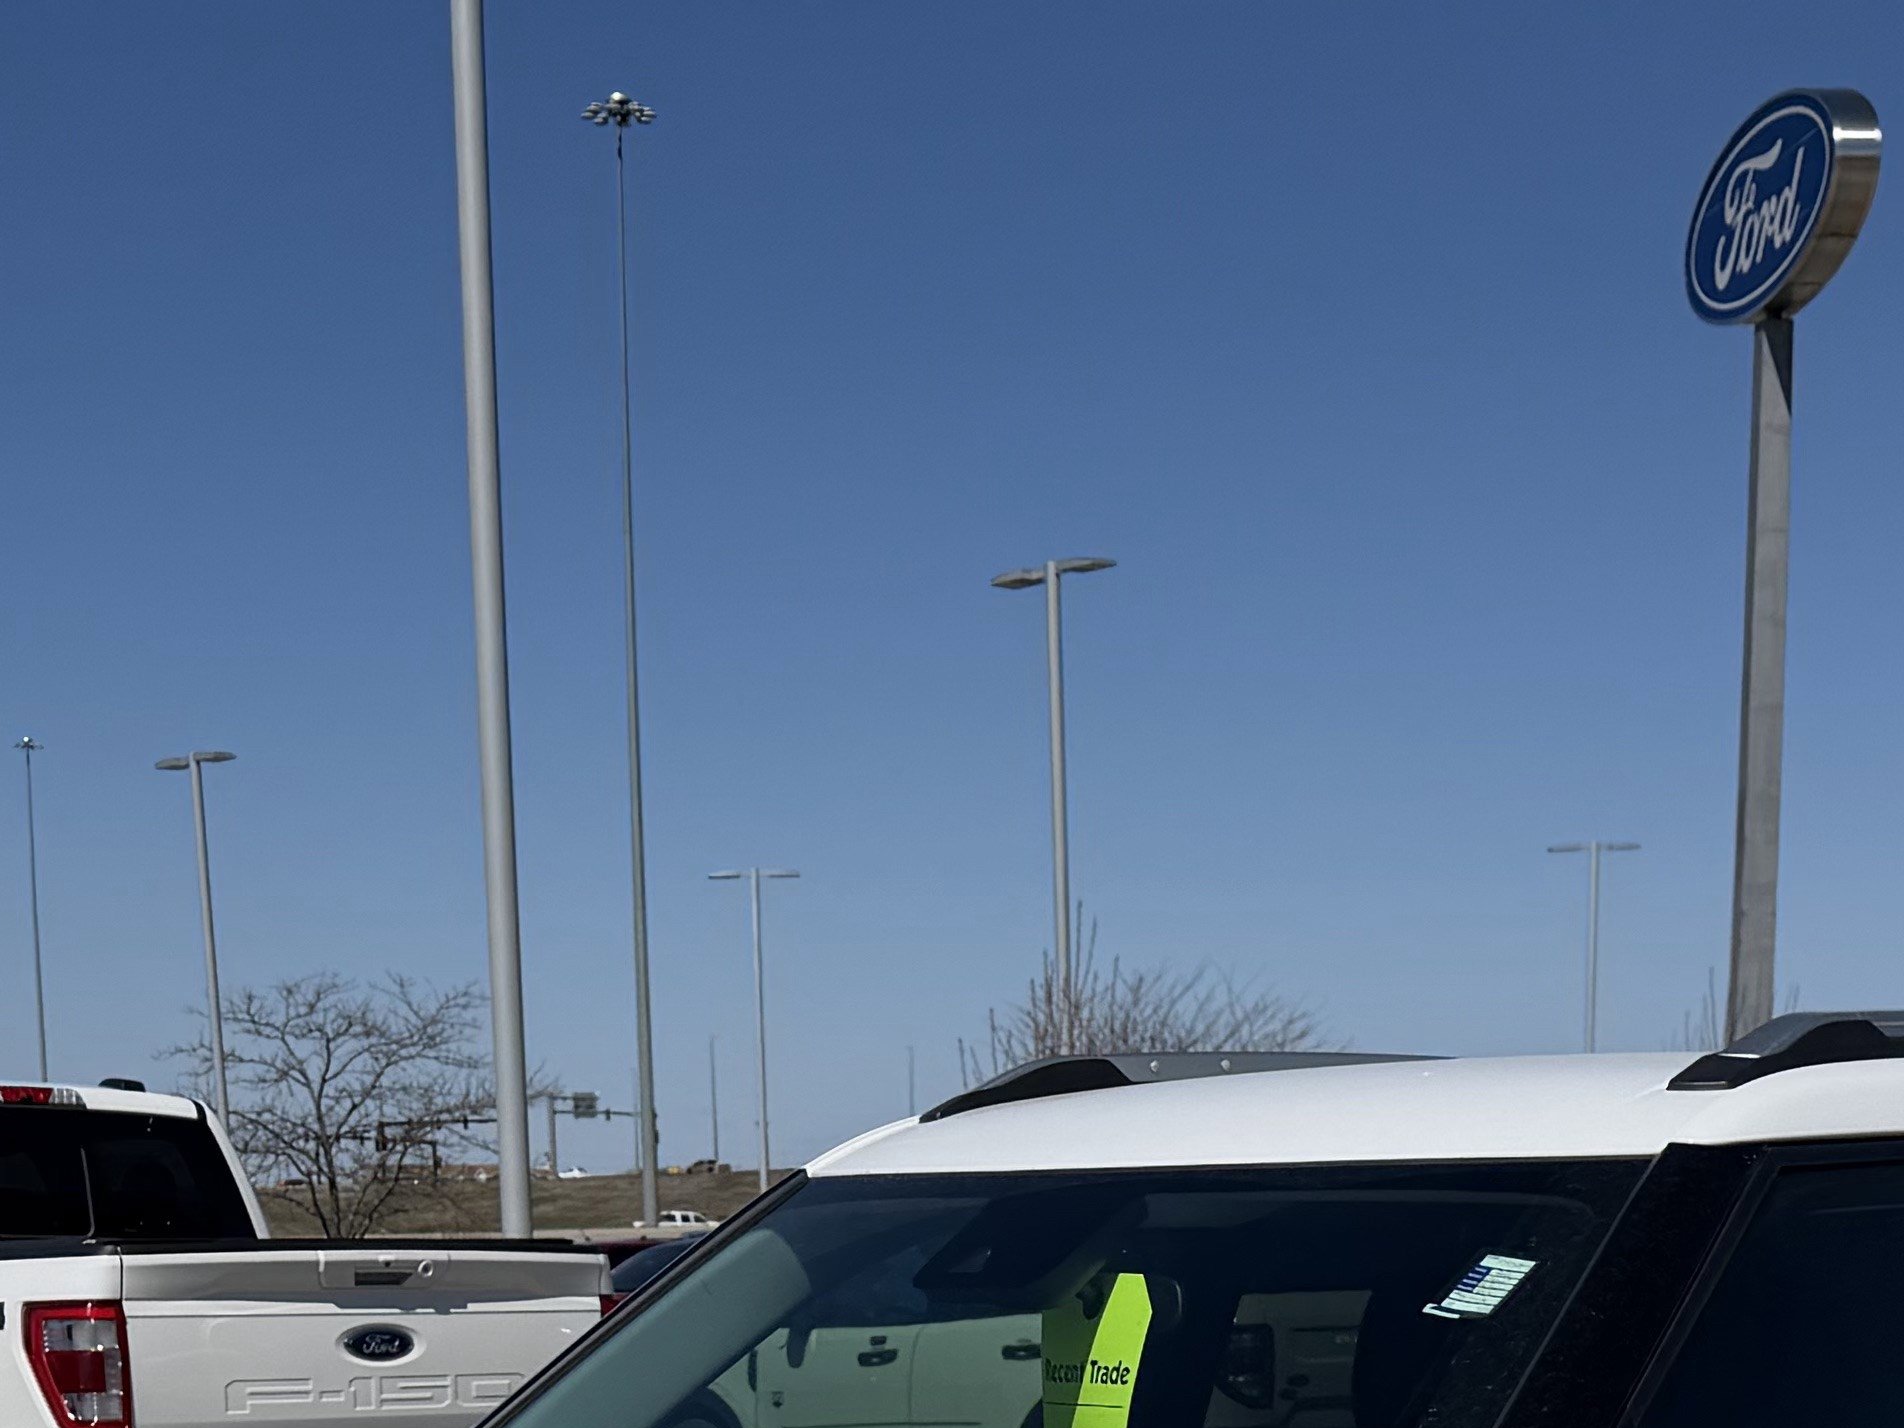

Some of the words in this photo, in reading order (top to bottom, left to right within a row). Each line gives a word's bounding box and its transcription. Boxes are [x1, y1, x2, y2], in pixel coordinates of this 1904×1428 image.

[1714, 138, 1805, 292] Ford
[362, 1334, 400, 1354] Ford
[1090, 1360, 1130, 1385] Trade
[225, 1372, 526, 1414] F-150
